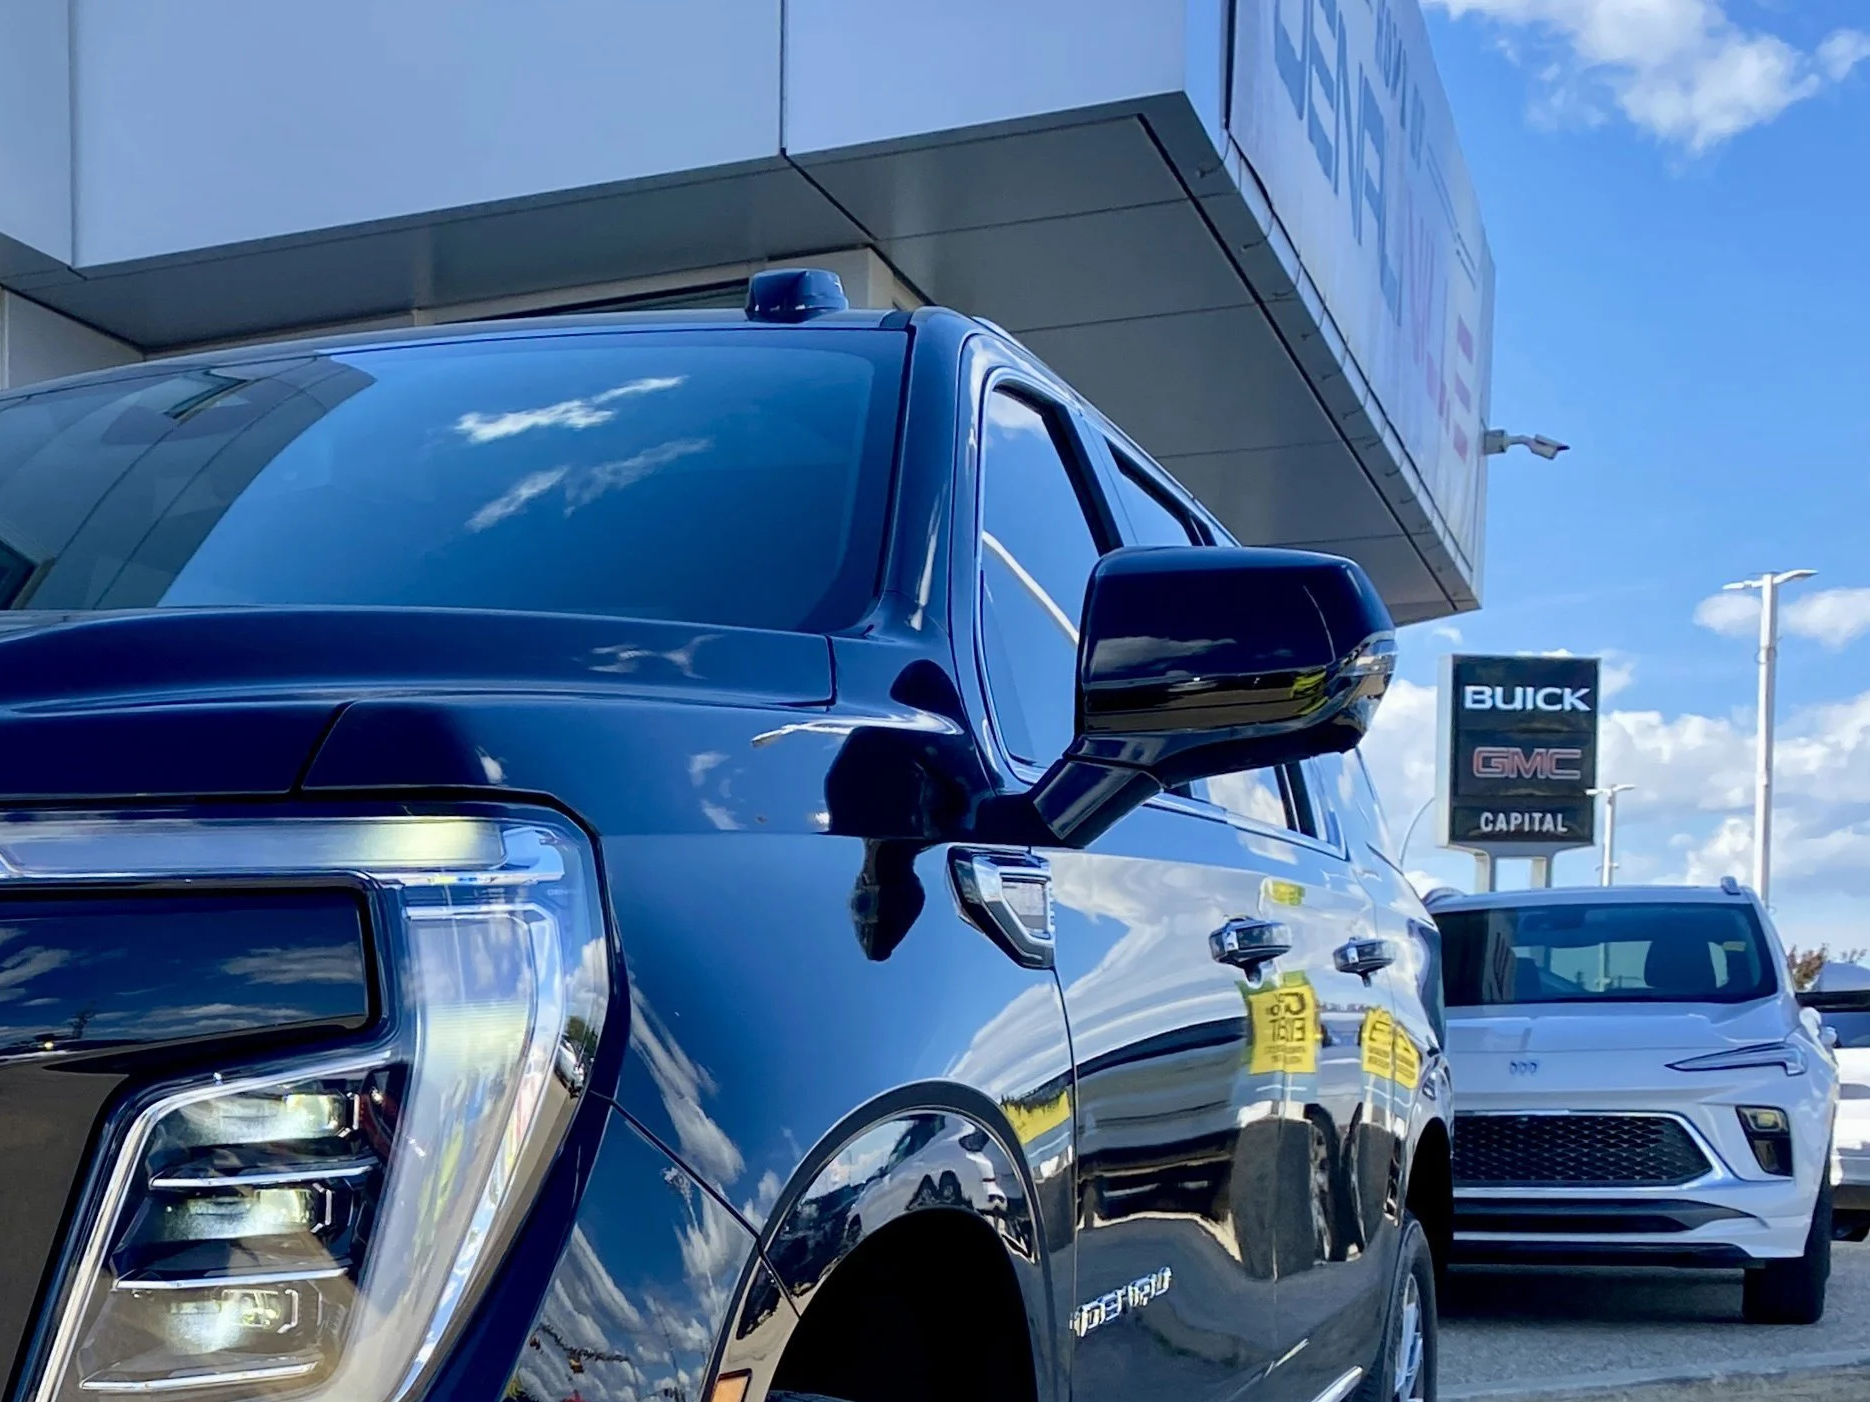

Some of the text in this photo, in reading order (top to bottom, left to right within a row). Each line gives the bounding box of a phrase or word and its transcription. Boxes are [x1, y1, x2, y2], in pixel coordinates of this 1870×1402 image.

[1464, 685, 1592, 712] BUICK
[1472, 746, 1583, 780] GMC
[1480, 811, 1568, 833] CAPITAL
